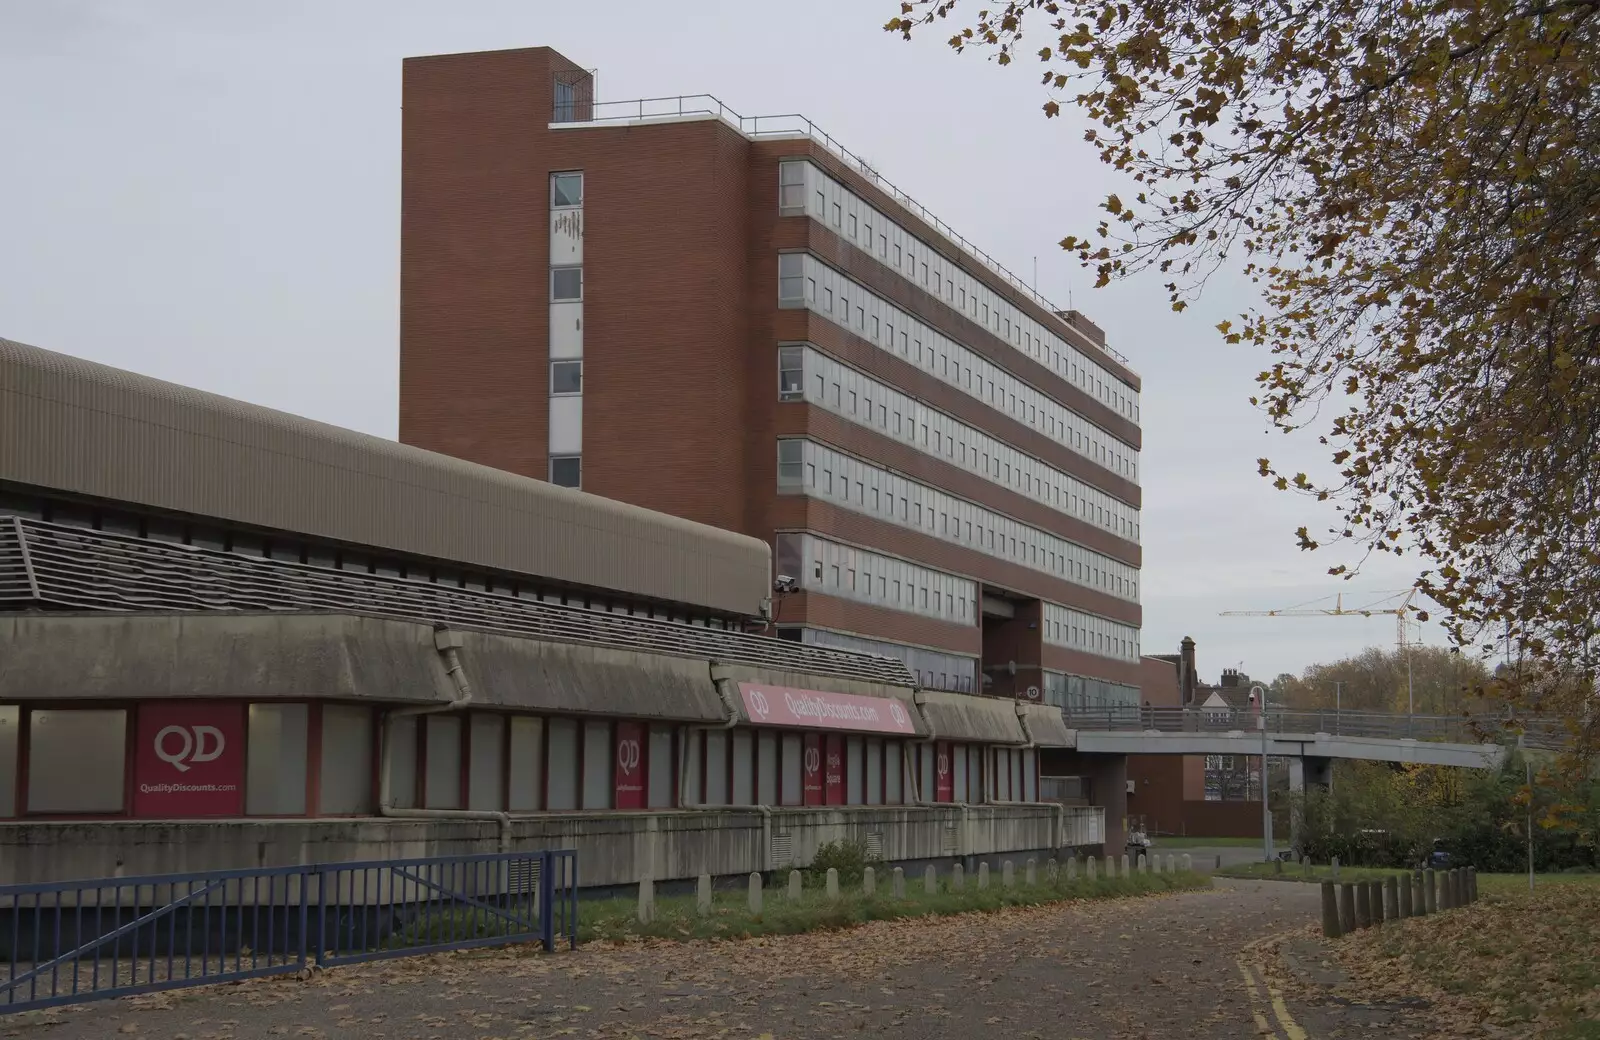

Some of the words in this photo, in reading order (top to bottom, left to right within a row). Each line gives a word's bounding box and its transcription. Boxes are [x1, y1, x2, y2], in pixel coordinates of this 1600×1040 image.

[1029, 688, 1037, 697] 10
[749, 690, 769, 720] QD
[784, 692, 880, 722] QualityDiscounts.com
[889, 703, 905, 728] QD
[154, 724, 225, 772] QD
[619, 739, 640, 776] QD
[805, 747, 819, 777] QD
[937, 753, 948, 779] QD
[140, 783, 236, 793] QualityDiscounts.com
